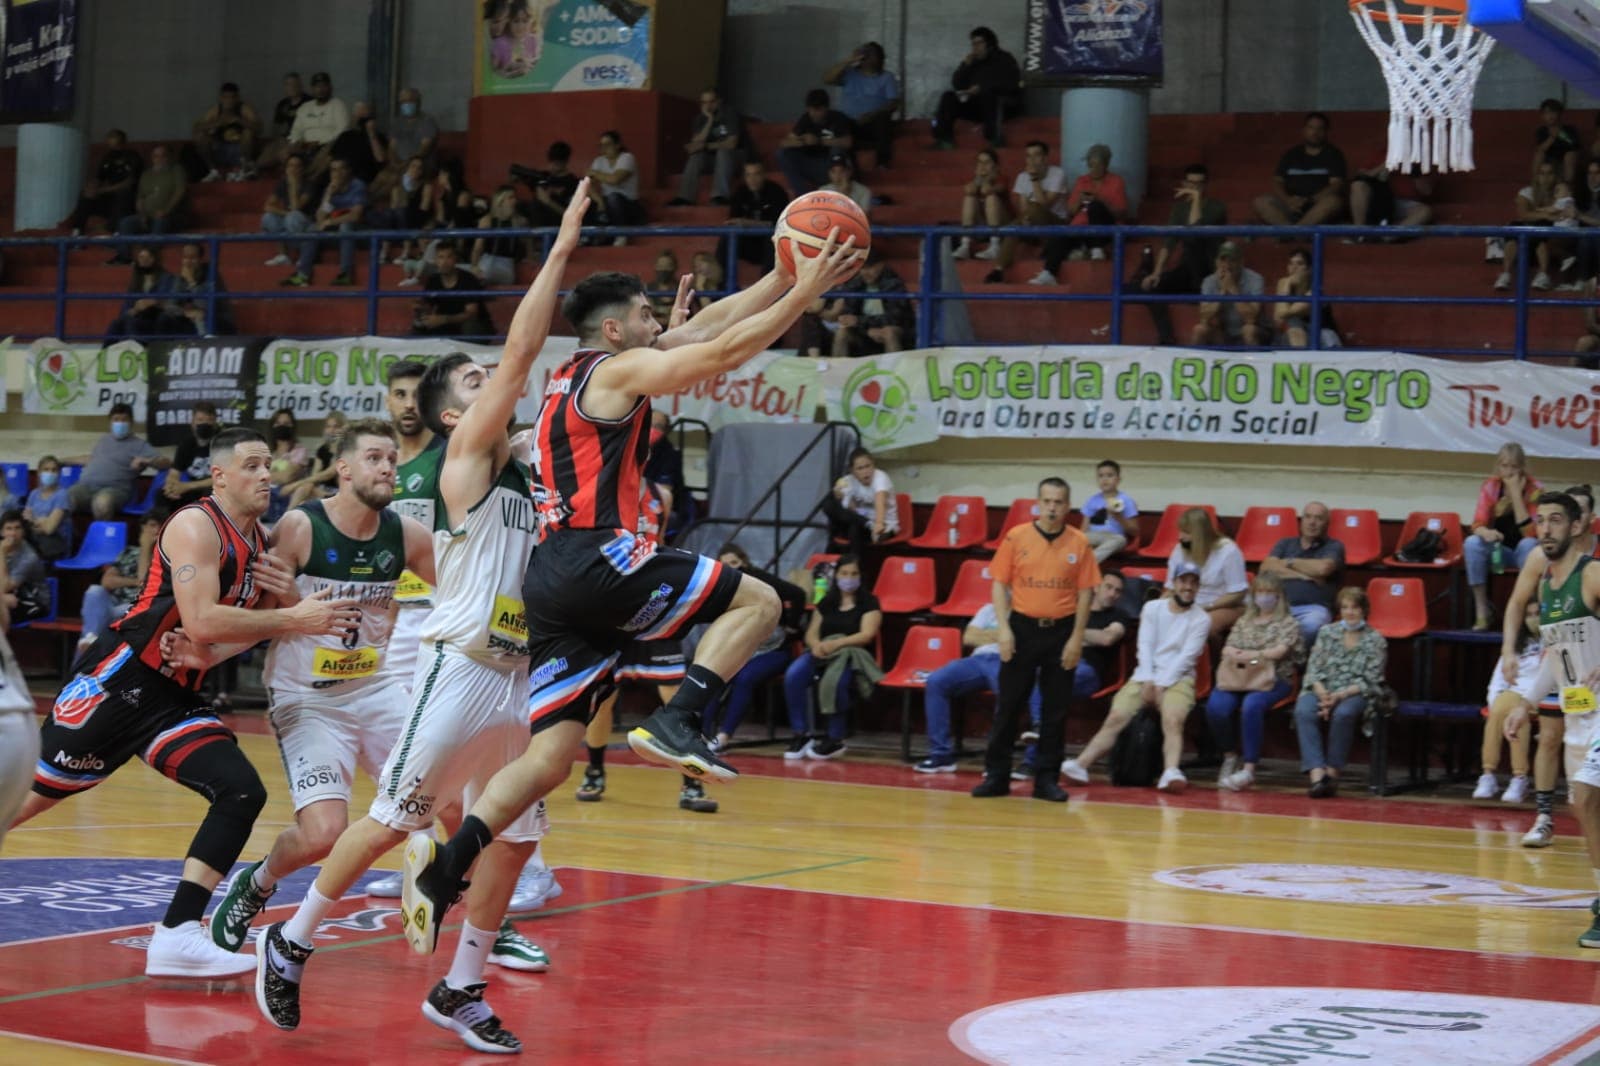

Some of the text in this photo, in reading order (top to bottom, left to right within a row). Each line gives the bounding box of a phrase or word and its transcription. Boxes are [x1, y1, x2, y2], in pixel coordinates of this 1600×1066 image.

[166, 347, 245, 376] ADAM
[272, 347, 341, 387] Río
[317, 391, 383, 413] Social
[925, 355, 1431, 424] Lotería de Río Negro
[936, 404, 1319, 436] ara Obras de Acción Social
[1448, 384, 1514, 429] Tu
[321, 658, 374, 672] Alvarez
[54, 750, 105, 771] Naldo
